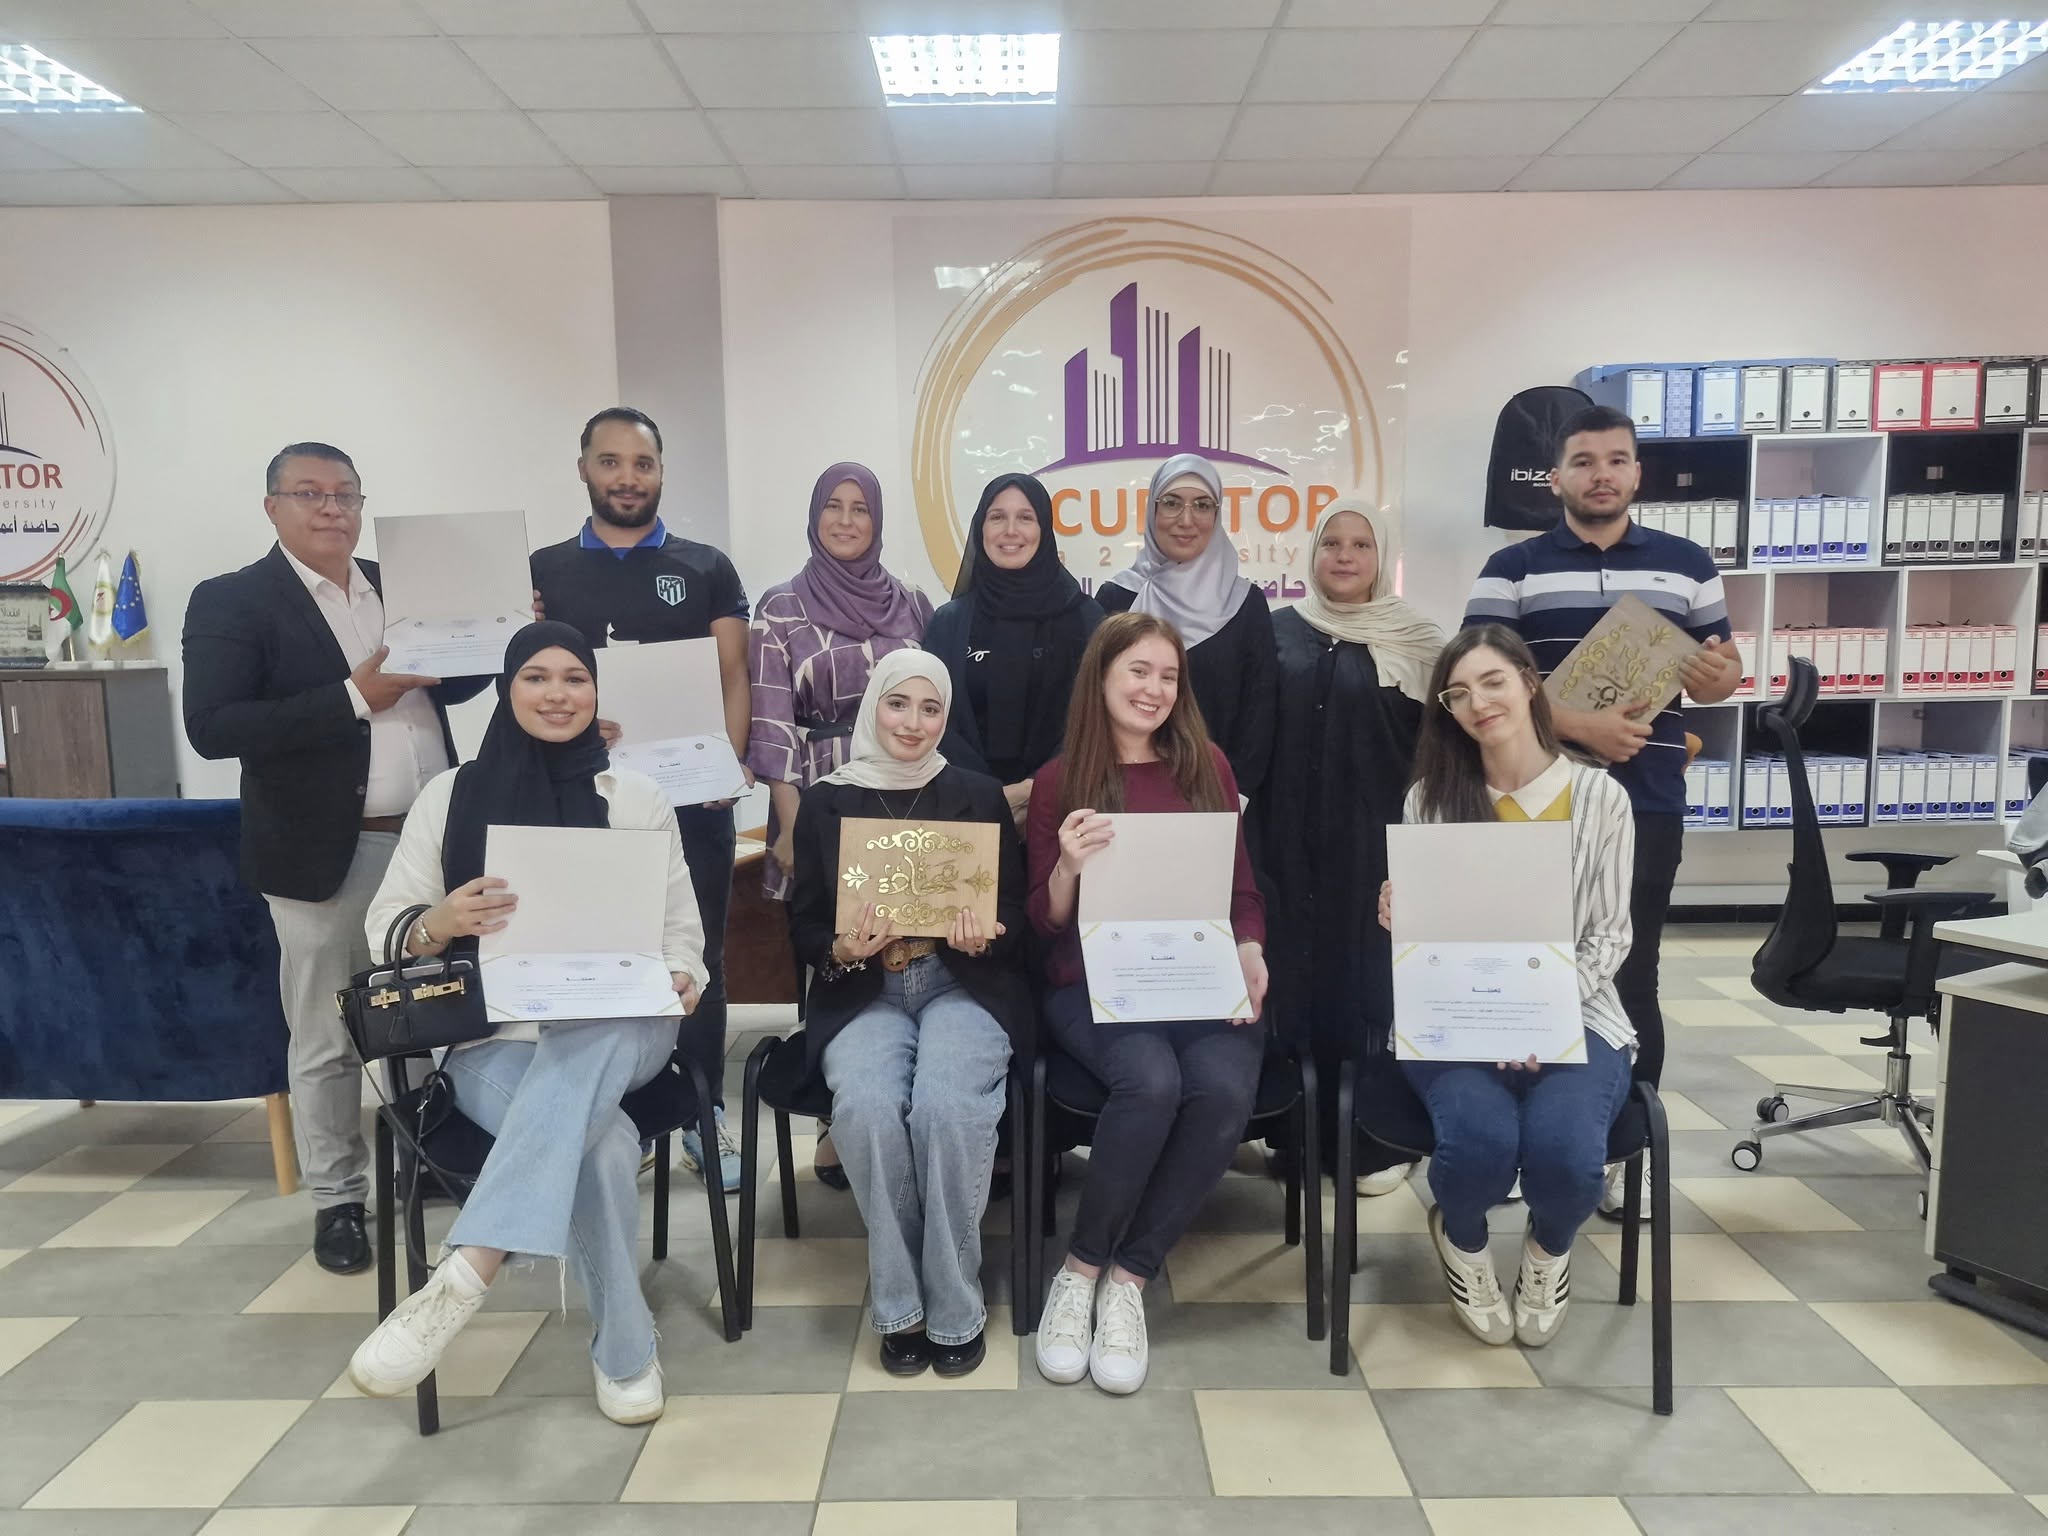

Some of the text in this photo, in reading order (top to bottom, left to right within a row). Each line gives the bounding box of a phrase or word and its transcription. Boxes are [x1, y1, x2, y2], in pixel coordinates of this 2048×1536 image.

[0, 463, 63, 489] TOR
[23, 519, 60, 533] حاضنة
[1099, 546, 1111, 566] 2
